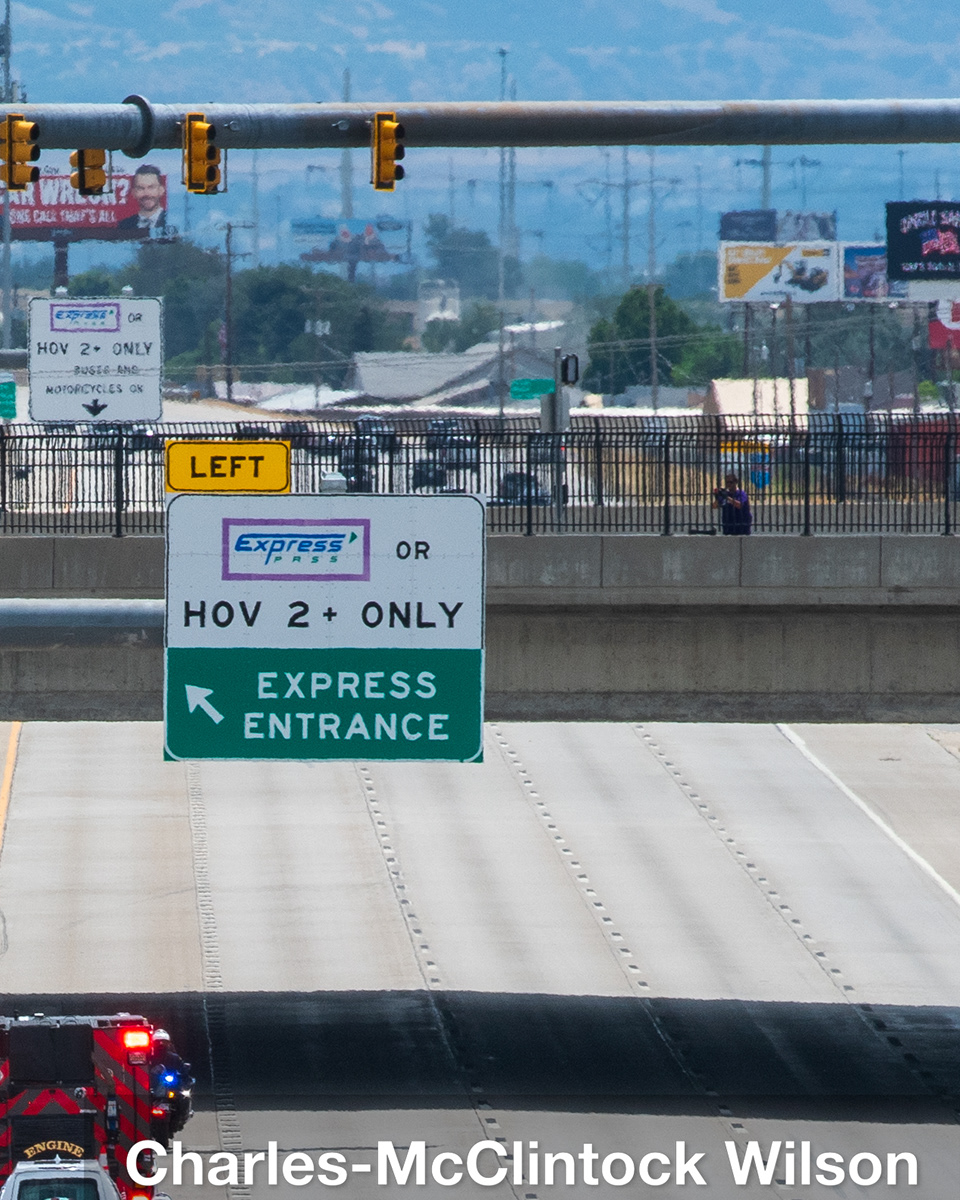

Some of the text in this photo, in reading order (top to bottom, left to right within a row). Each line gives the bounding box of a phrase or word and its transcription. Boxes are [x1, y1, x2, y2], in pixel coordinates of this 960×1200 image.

[33, 209, 57, 223] CALL
[98, 209, 117, 223] ALL
[127, 312, 142, 323] OR
[36, 341, 153, 356] HOV 2+ ONLY
[73, 365, 139, 375] BUSES AND
[46, 384, 143, 395] MOTORCYCLES OK
[190, 455, 265, 478] LEFT
[235, 533, 430, 565] Express OR
[273, 555, 338, 564] PASS
[184, 600, 464, 629] HOV 2+ ONLY
[257, 671, 437, 700] EXPRESS
[243, 712, 450, 741] ENTRANCE
[23, 1140, 85, 1159] ENGINE
